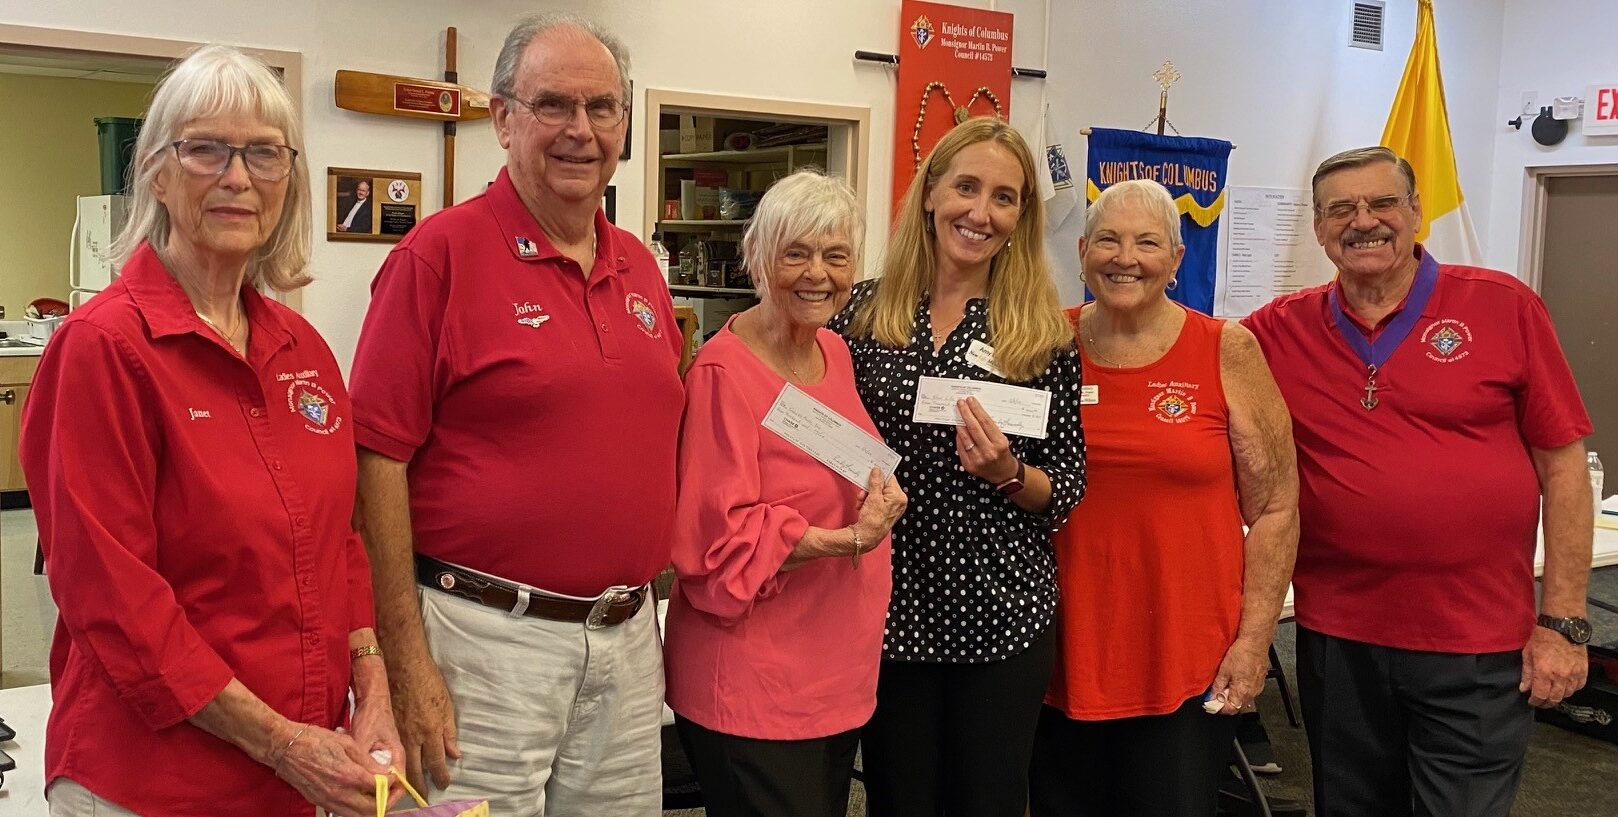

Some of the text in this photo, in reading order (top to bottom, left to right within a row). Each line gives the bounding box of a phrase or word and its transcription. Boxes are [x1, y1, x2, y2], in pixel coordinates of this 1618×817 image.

[942, 22, 1008, 41] Knights of Columbus
[941, 38, 967, 51] Monsignor
[968, 41, 985, 51] Martin
[992, 45, 1007, 53] Power
[954, 50, 974, 60] Council
[1100, 161, 1217, 192] KNIGHTS OF COLUMBUS
[513, 301, 542, 316] John
[189, 407, 211, 421] Janet
